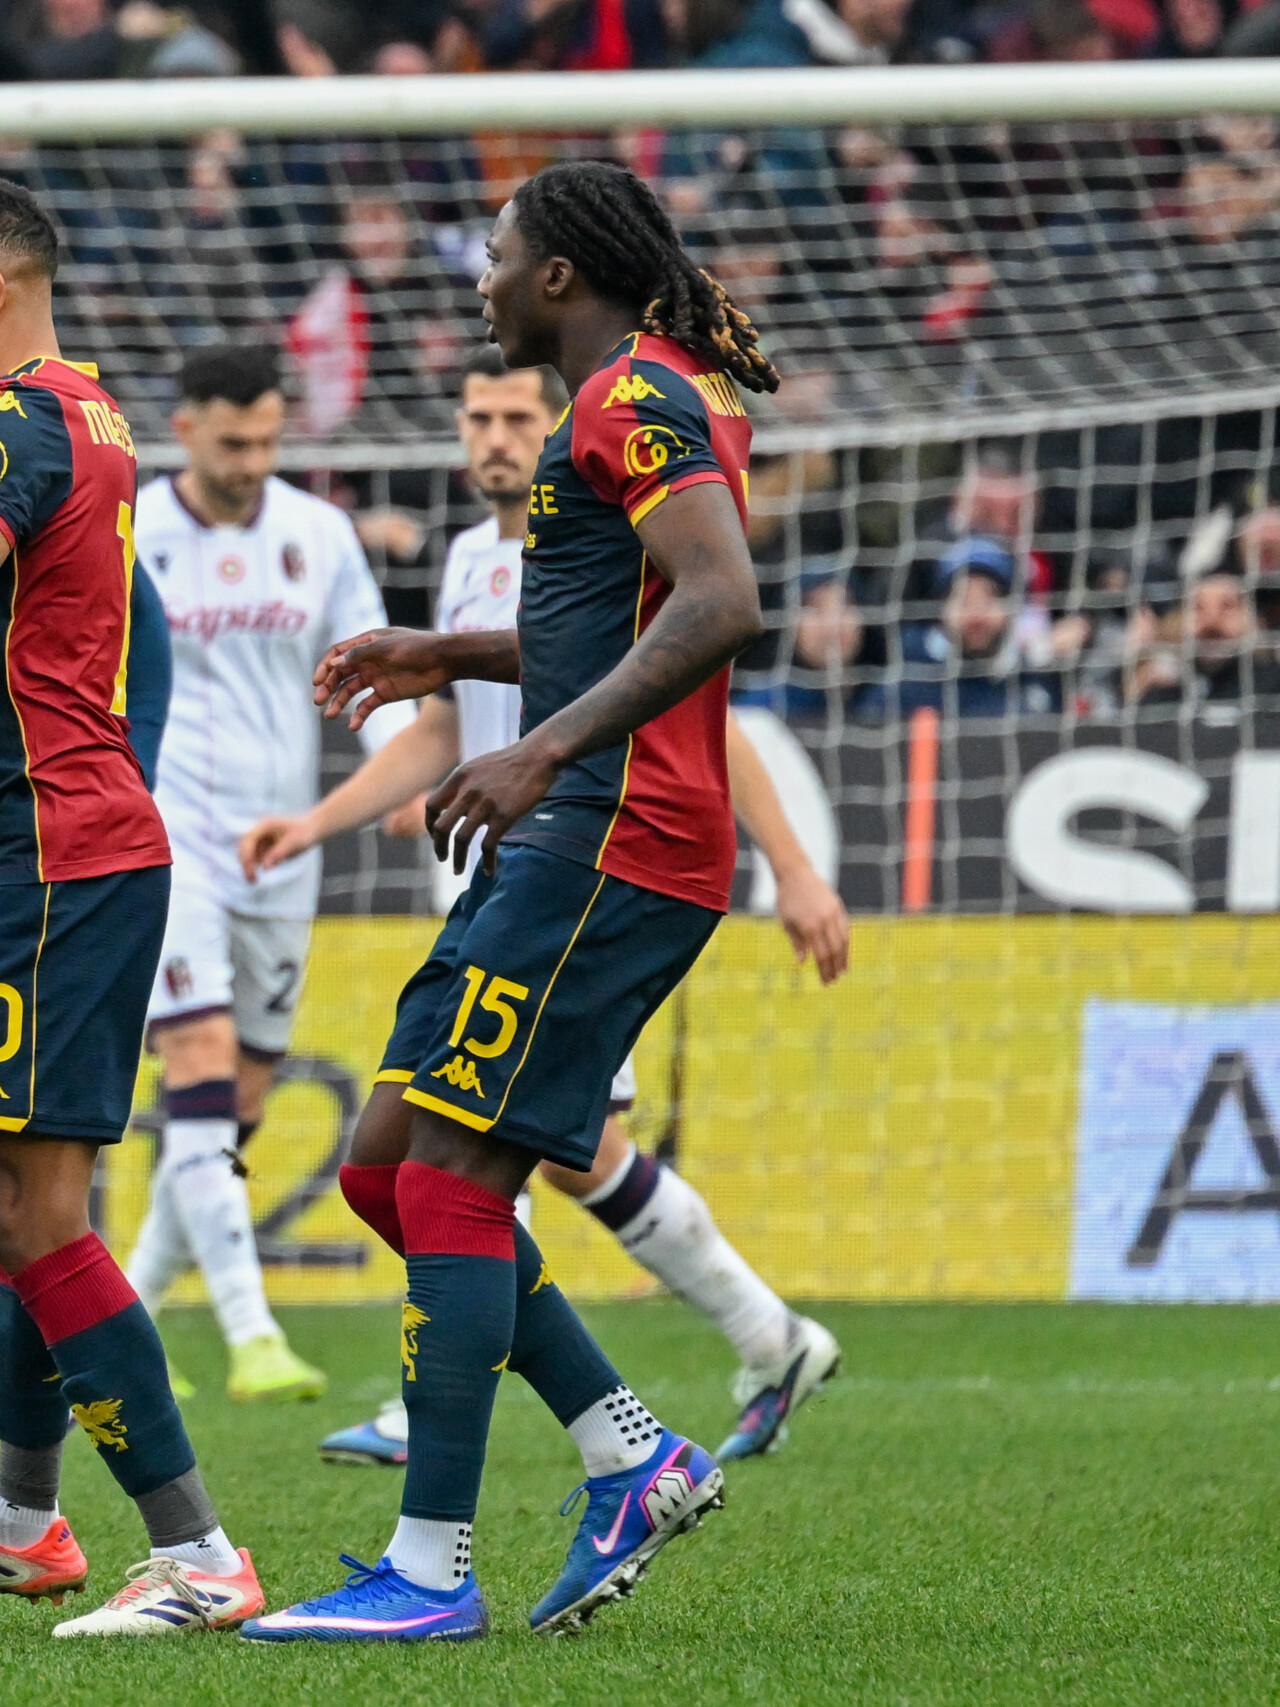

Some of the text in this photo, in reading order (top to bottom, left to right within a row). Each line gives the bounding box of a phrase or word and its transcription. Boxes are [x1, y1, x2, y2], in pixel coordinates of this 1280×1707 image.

[527, 484, 559, 515] EE
[110, 500, 136, 717] 1
[447, 964, 530, 1059] 15
